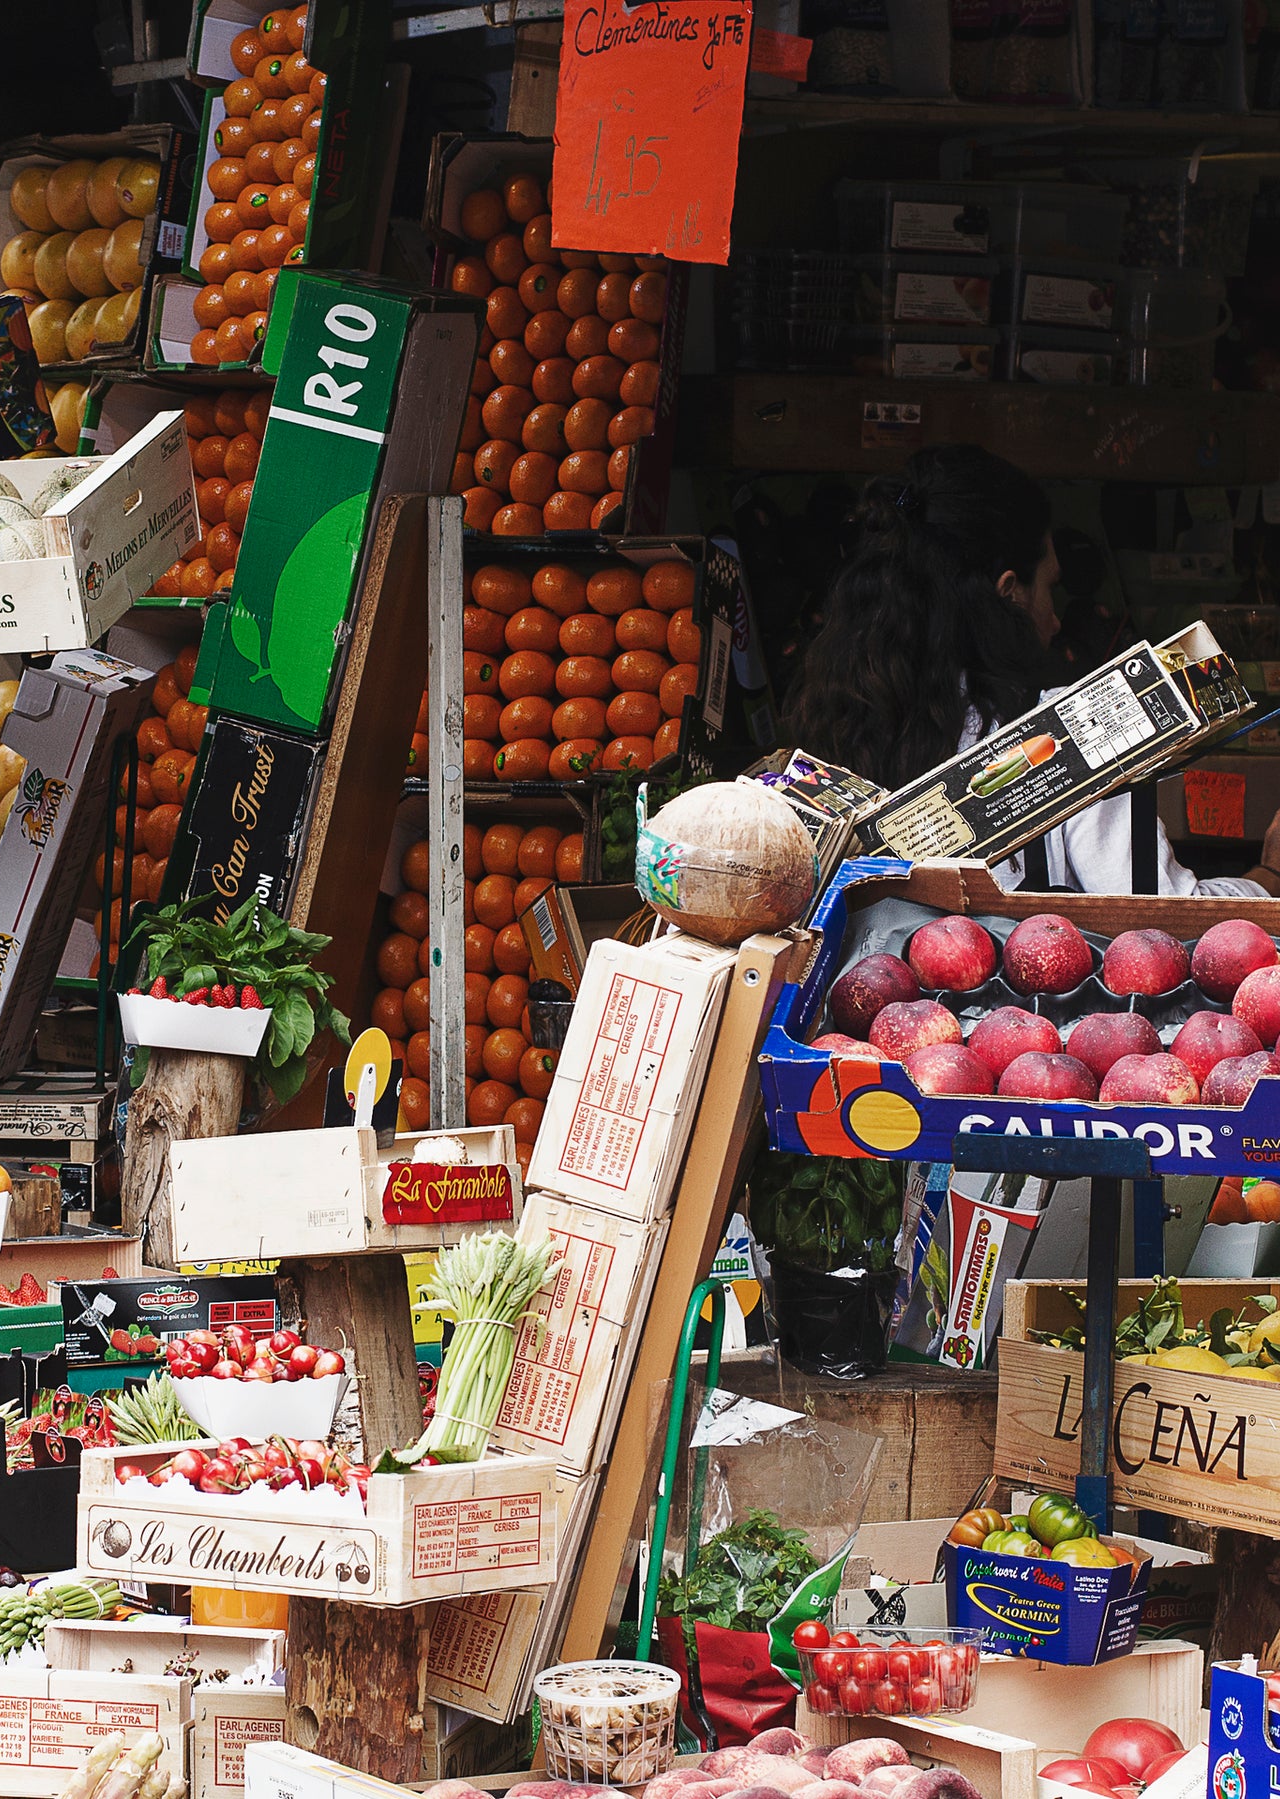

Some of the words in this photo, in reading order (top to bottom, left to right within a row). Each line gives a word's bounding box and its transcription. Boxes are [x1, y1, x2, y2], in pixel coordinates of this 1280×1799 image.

[303, 303, 378, 418] R10
[105, 537, 138, 580] MELONS
[148, 487, 192, 541] MERVEILLES
[231, 741, 276, 830] Trust
[29, 778, 70, 852] LIMDOR
[211, 832, 251, 899] Can
[614, 994, 630, 1026] EXTRA
[620, 1013, 639, 1055] CERISES
[594, 1054, 613, 1093] FRANCE
[572, 1106, 590, 1144] AGENES
[391, 1166, 421, 1205] La
[424, 1165, 508, 1213] Farandole
[554, 1268, 573, 1310] CERISES
[953, 1234, 989, 1333] SANTOMMAS
[519, 1325, 534, 1357] ORIGINE:
[562, 1336, 578, 1371] CALIBRE:
[502, 1400, 516, 1425] EARL
[510, 1361, 527, 1399] AGENES
[518, 1363, 535, 1409] CHAMBERTS"
[529, 1371, 543, 1405] MONTECH
[1114, 1381, 1248, 1481] CEÑA
[467, 1510, 492, 1521] FRANCE
[493, 1521, 520, 1533] CERISES
[510, 1507, 530, 1517] EXTRA
[131, 1520, 183, 1566] Les
[187, 1523, 334, 1582] Chamberts
[1032, 1567, 1066, 1592] Italia
[996, 1604, 1060, 1625] TAORMINA
[1008, 1594, 1034, 1607] Teatro
[1036, 1599, 1061, 1610] Greco
[32, 1702, 64, 1711] ORIGINE:
[44, 1711, 82, 1722] FRANCE
[98, 1705, 122, 1714] PRODUIT
[111, 1715, 142, 1726] EXTRA
[32, 1723, 65, 1733] PRODUIT:
[32, 1735, 63, 1744] VARIETE:
[219, 1732, 234, 1741] "LES
[234, 1732, 282, 1743] CHAMBERTS"
[220, 1720, 242, 1732] EARL
[243, 1721, 281, 1733] AGENES
[32, 1746, 65, 1756] CALIBRE:
